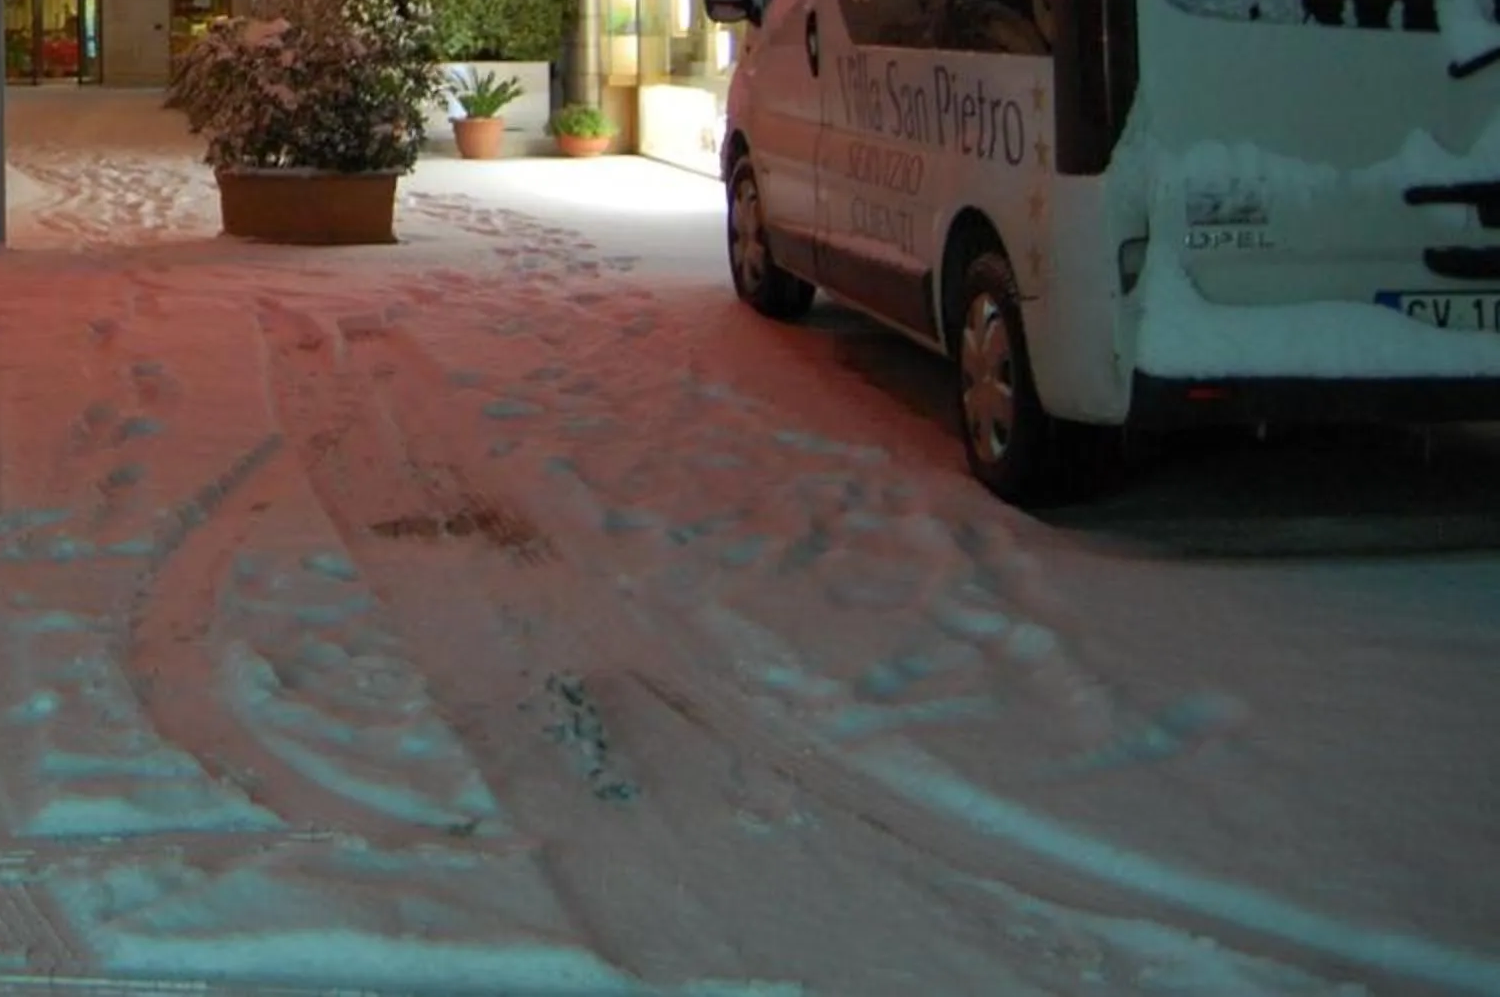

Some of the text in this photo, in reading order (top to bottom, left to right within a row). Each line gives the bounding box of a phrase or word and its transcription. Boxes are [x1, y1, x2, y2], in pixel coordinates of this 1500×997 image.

[837, 53, 1025, 167] Villa San Pietro
[1183, 230, 1276, 250] OPEL
